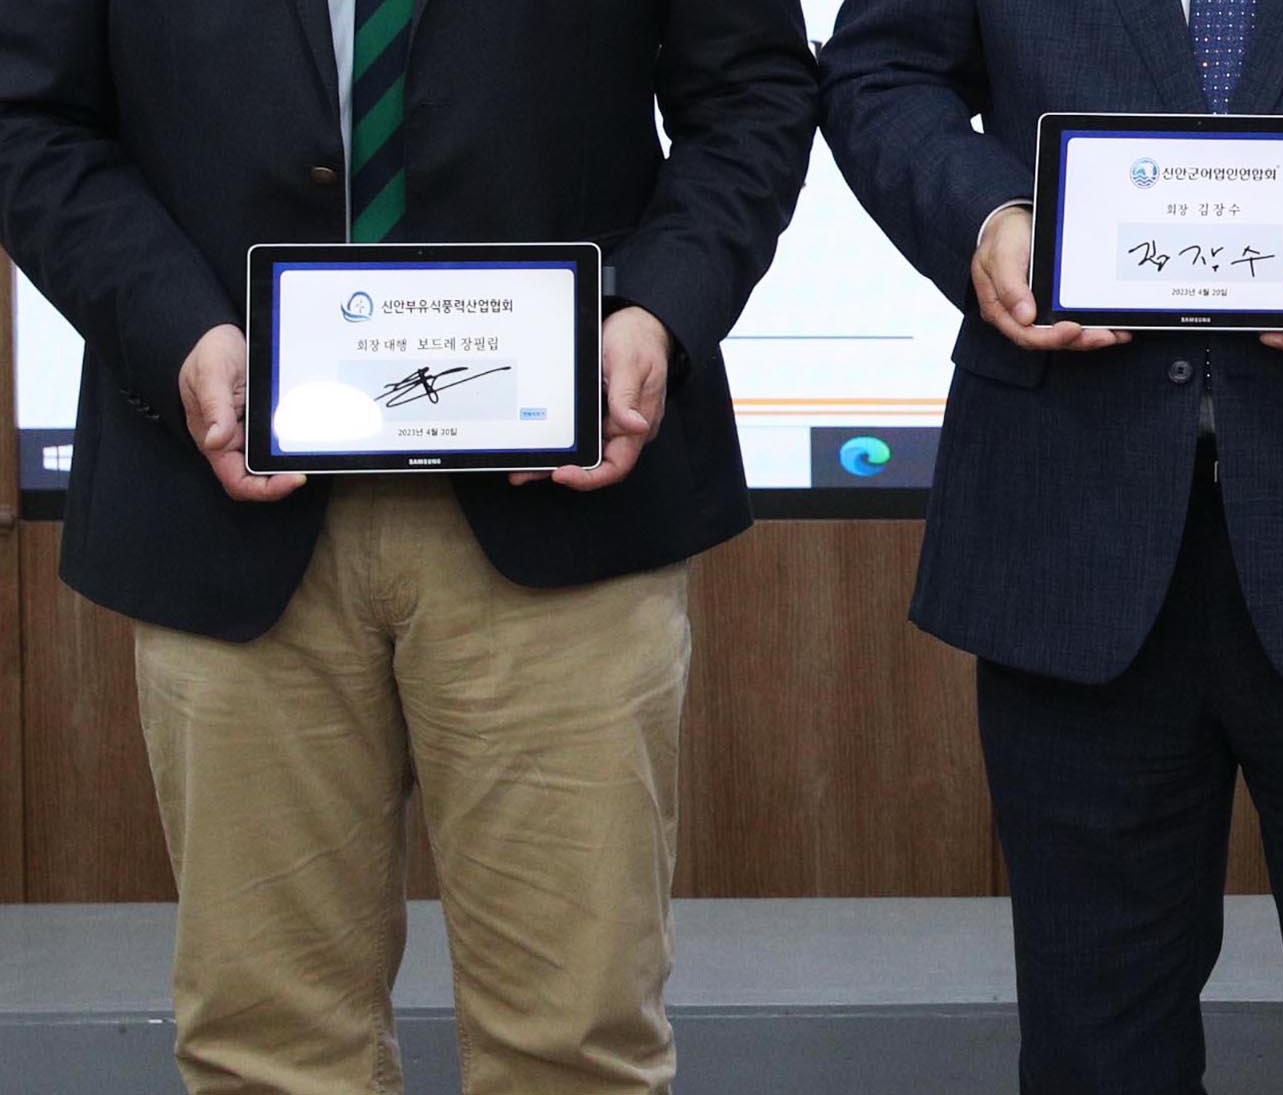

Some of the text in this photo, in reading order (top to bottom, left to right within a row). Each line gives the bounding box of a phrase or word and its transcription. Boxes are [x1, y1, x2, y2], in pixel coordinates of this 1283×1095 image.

[1162, 166, 1277, 182] 신안군어업인연합회
[1167, 203, 1188, 216] 회장
[381, 299, 513, 315] 신안부유식풍력산업협회
[357, 339, 380, 353] 회장
[417, 337, 457, 352] 보드레
